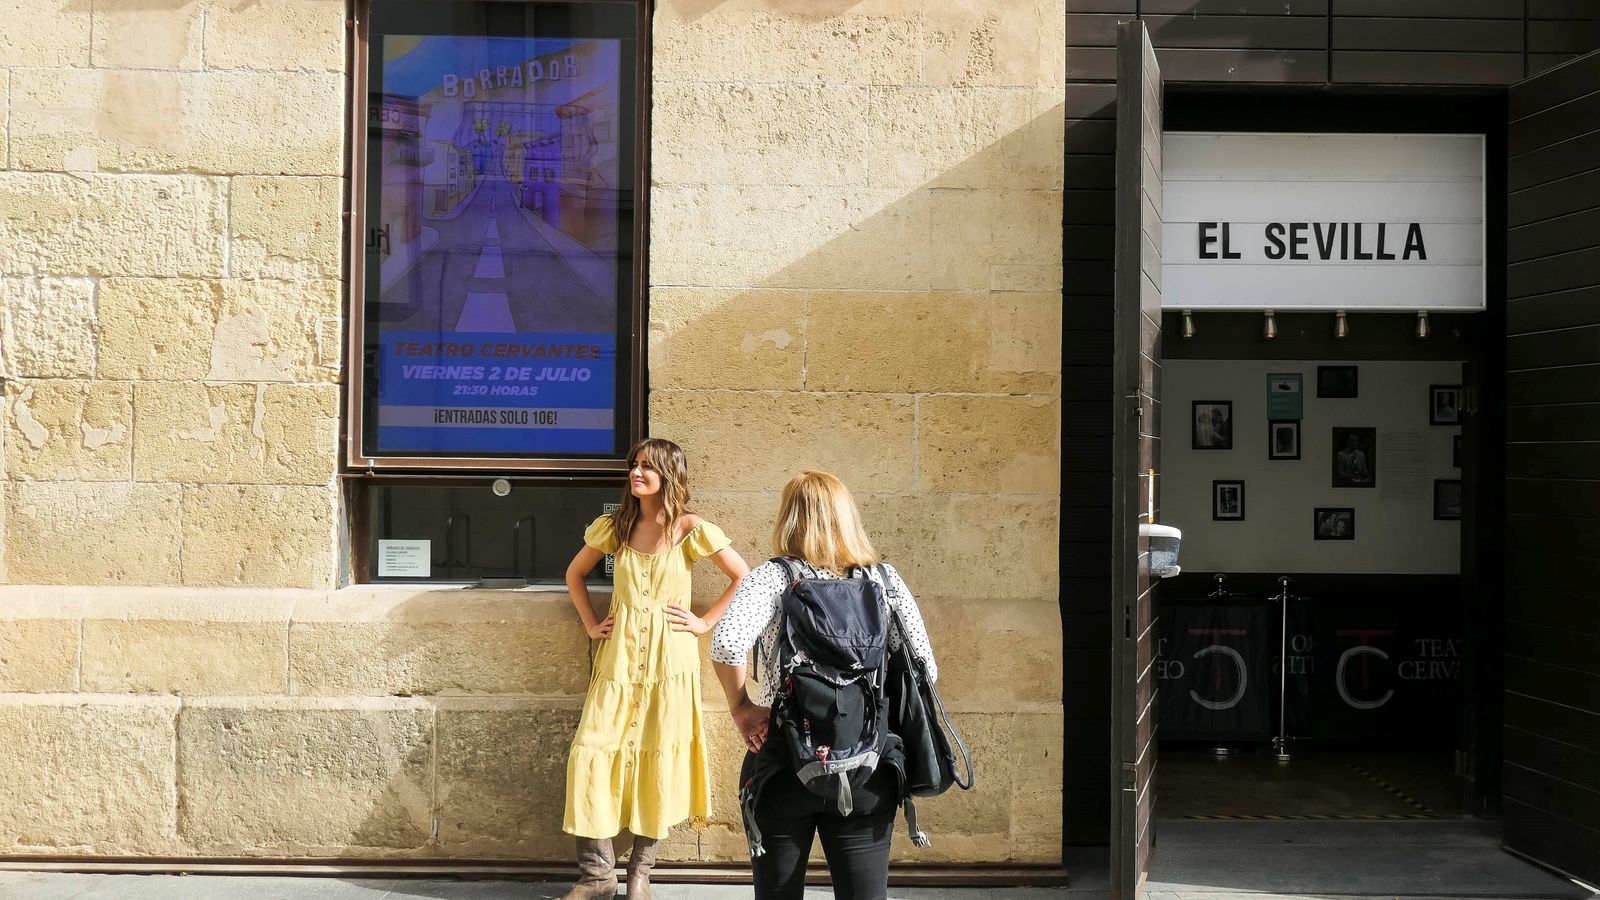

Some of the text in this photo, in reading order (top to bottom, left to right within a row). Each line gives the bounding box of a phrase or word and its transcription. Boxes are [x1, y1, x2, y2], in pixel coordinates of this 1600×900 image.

[443, 54, 577, 98] BORRADOR
[1199, 222, 1427, 260] EL SEVILLA
[395, 341, 601, 359] TEATRO CERVANTES
[402, 365, 592, 382] VIERNES 2 DE JULIO
[453, 384, 539, 397] 21:30 HORAS
[434, 409, 558, 425] ¡ENTRADAS SOLO 10€!
